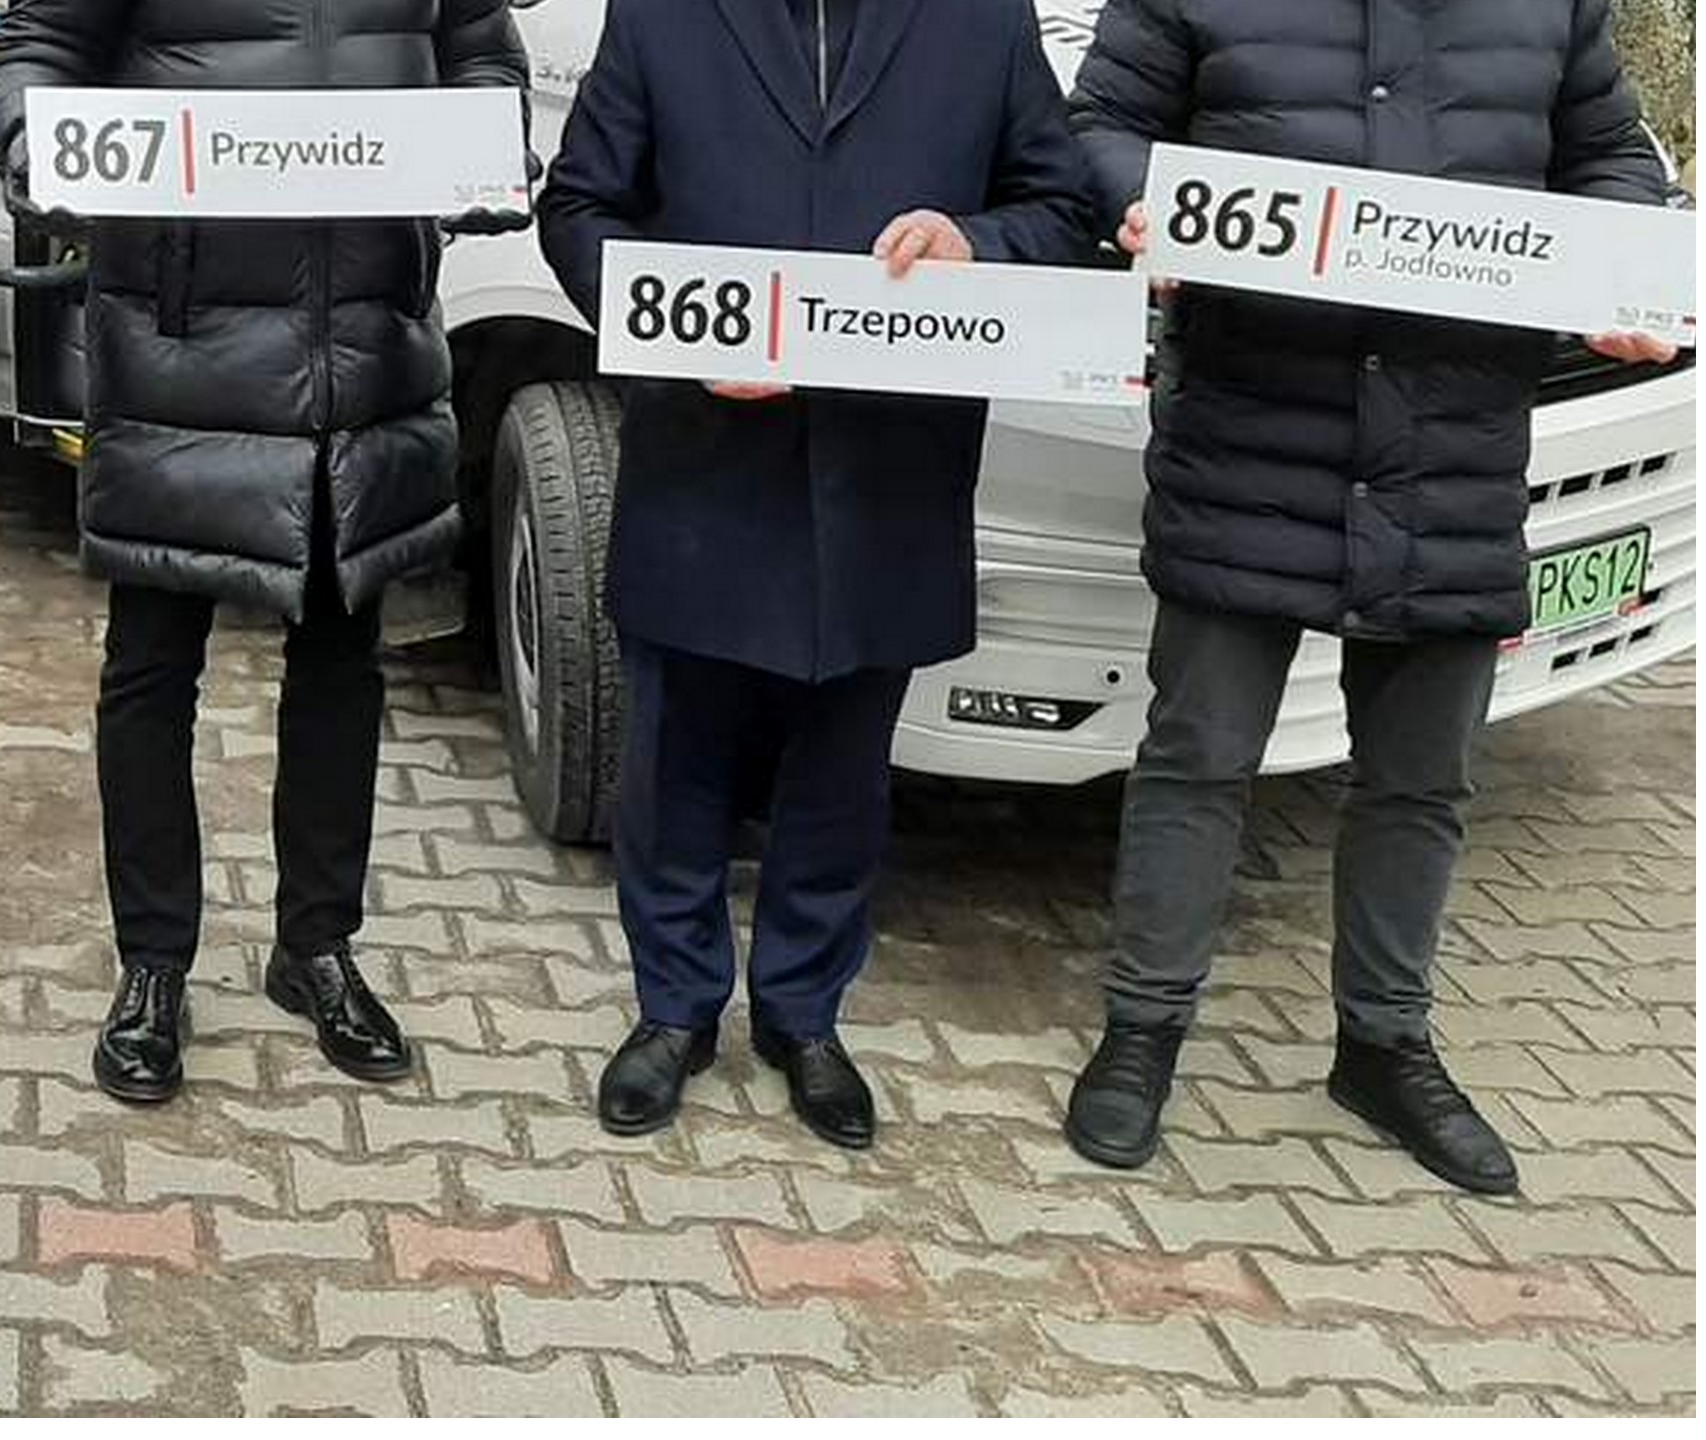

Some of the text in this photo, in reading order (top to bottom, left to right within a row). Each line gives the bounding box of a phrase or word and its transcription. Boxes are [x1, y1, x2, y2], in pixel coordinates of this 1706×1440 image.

[53, 118, 385, 183] 867 Przywidz
[1168, 179, 1554, 261] 865 Przywidz
[1344, 249, 1368, 270] p.
[626, 274, 1006, 345] 868 Trzepowo
[1536, 540, 1641, 620] PKS12
